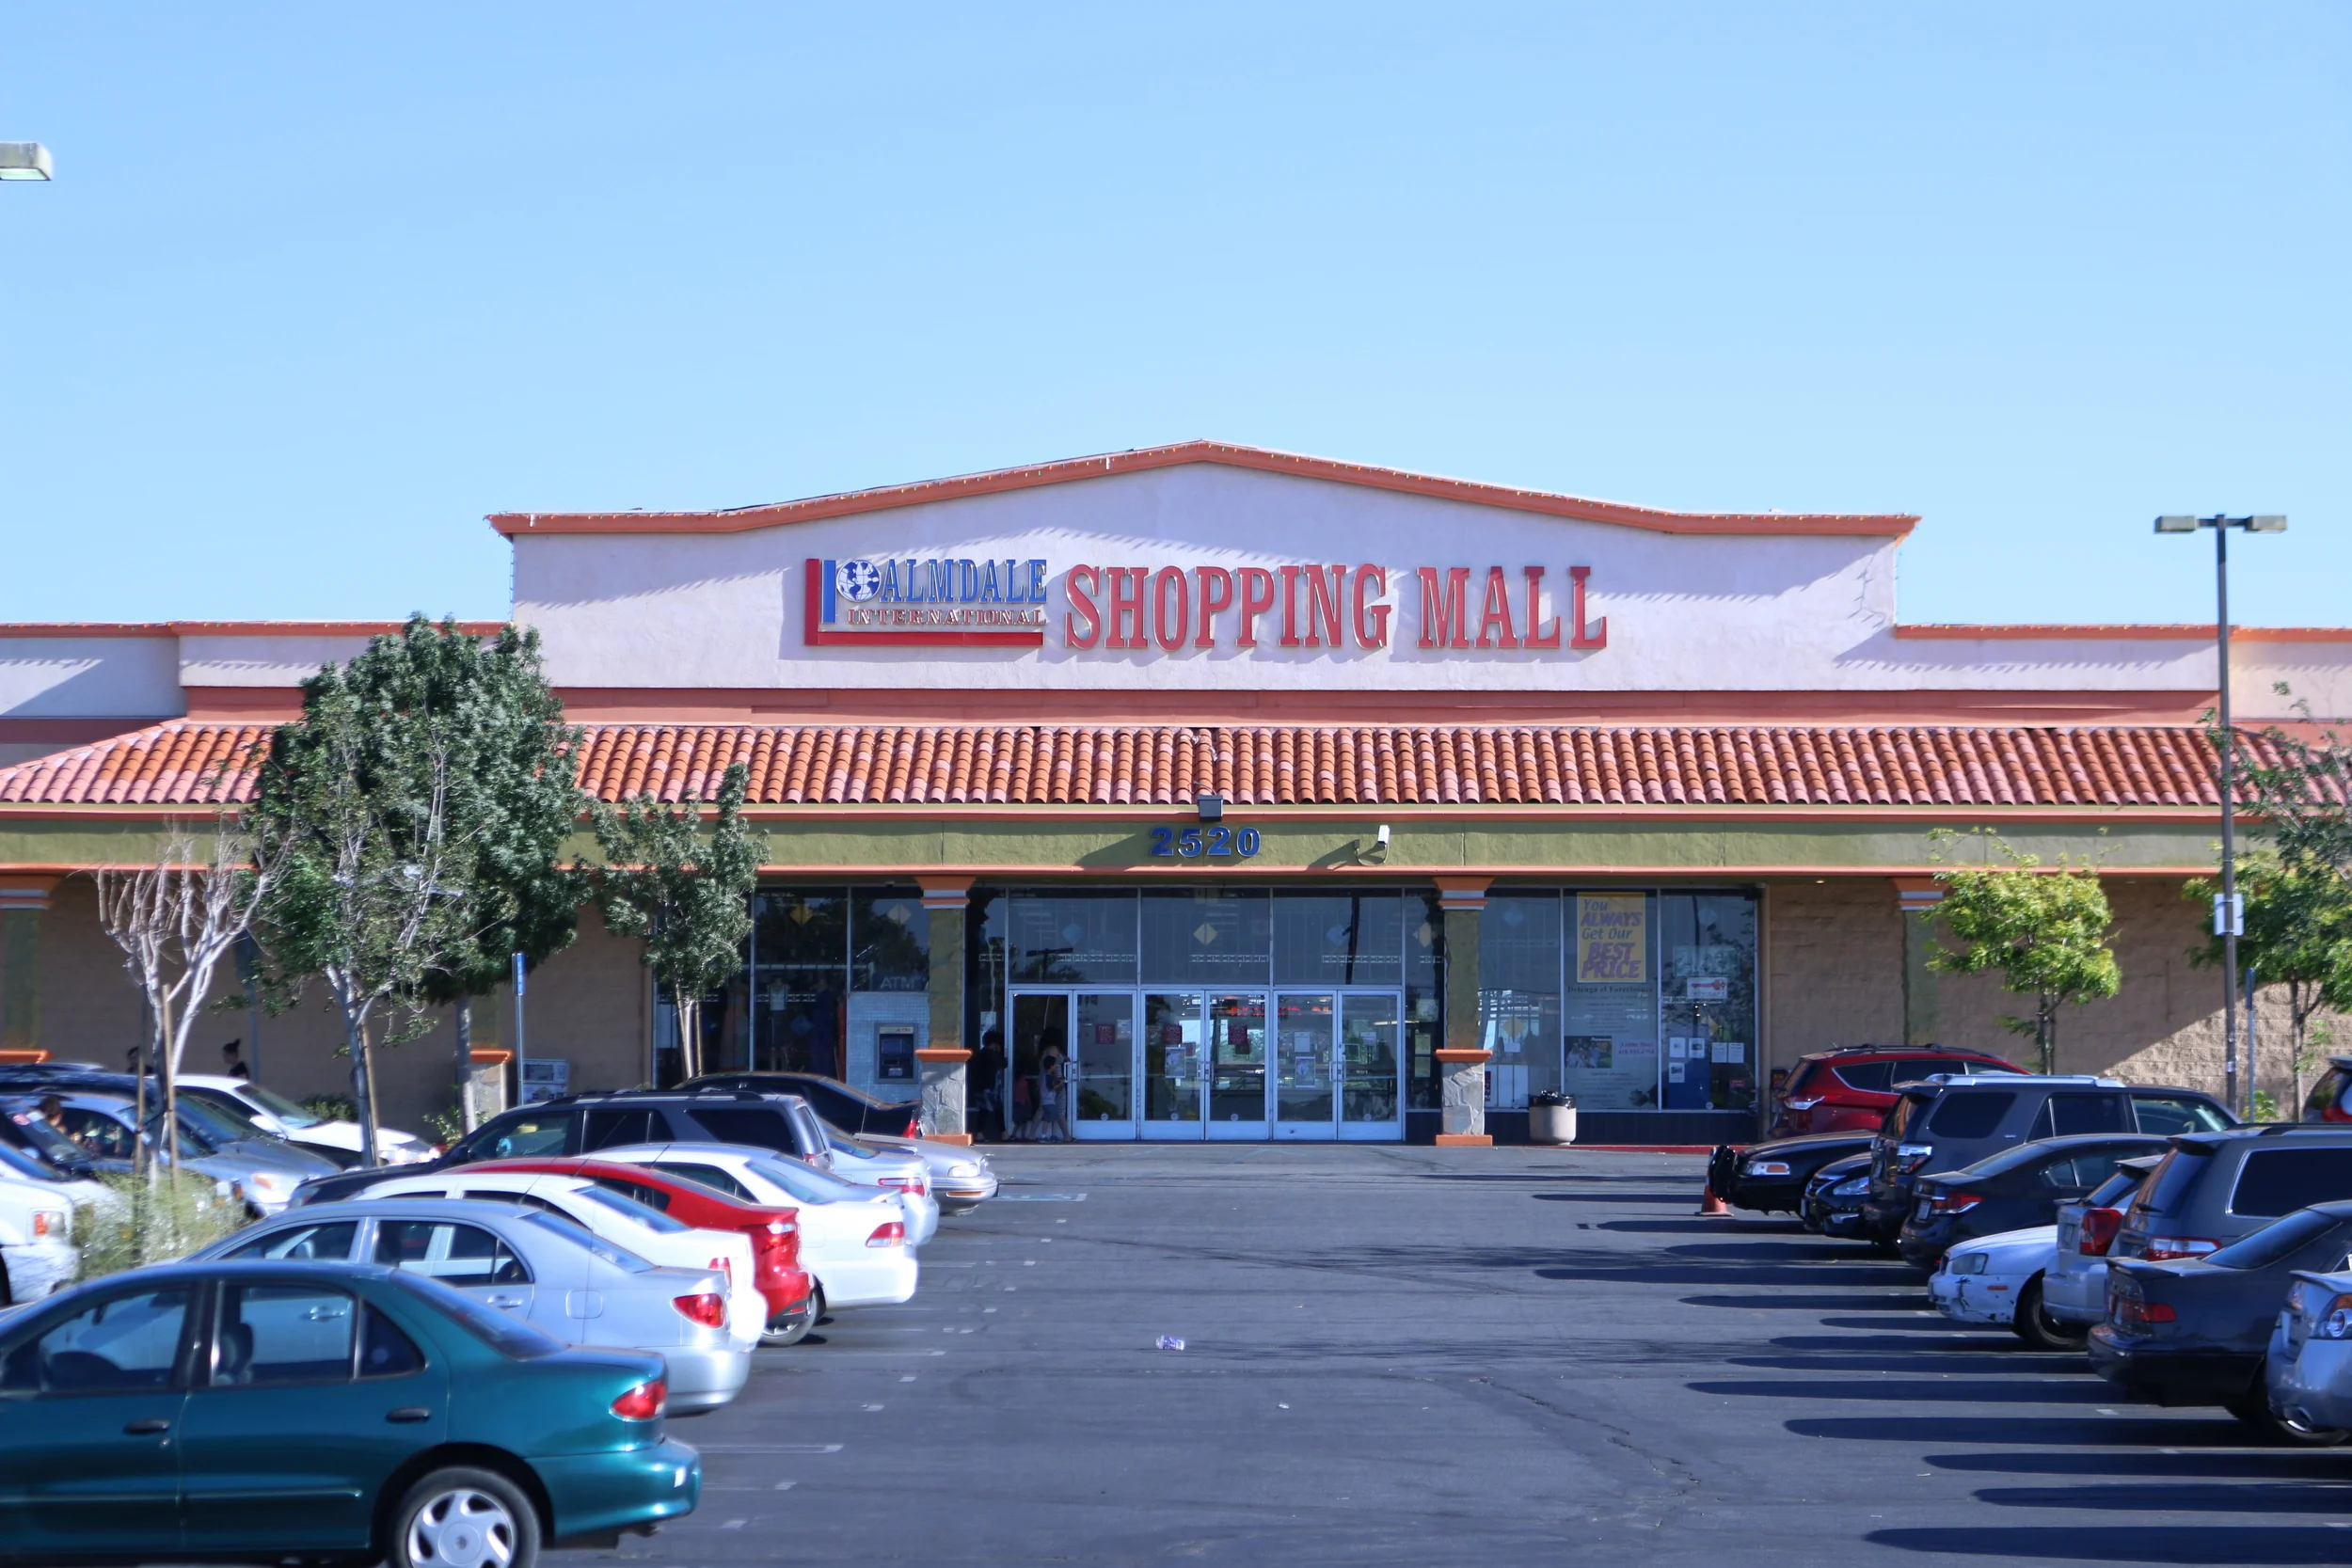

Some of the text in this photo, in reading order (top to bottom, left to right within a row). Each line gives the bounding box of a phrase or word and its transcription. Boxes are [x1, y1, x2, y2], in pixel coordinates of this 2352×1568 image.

[1065, 564, 1606, 651] SHOPPING MALL
[848, 609, 1046, 625] INTERNATIONAL
[1150, 827, 1262, 858] 2520
[1583, 899, 1608, 911] You
[1581, 912, 1643, 927] ALWAYS
[1581, 927, 1633, 940] Get Our
[1587, 942, 1635, 961] BEST
[1581, 960, 1642, 979] PRICE
[880, 976, 915, 990] ATM
